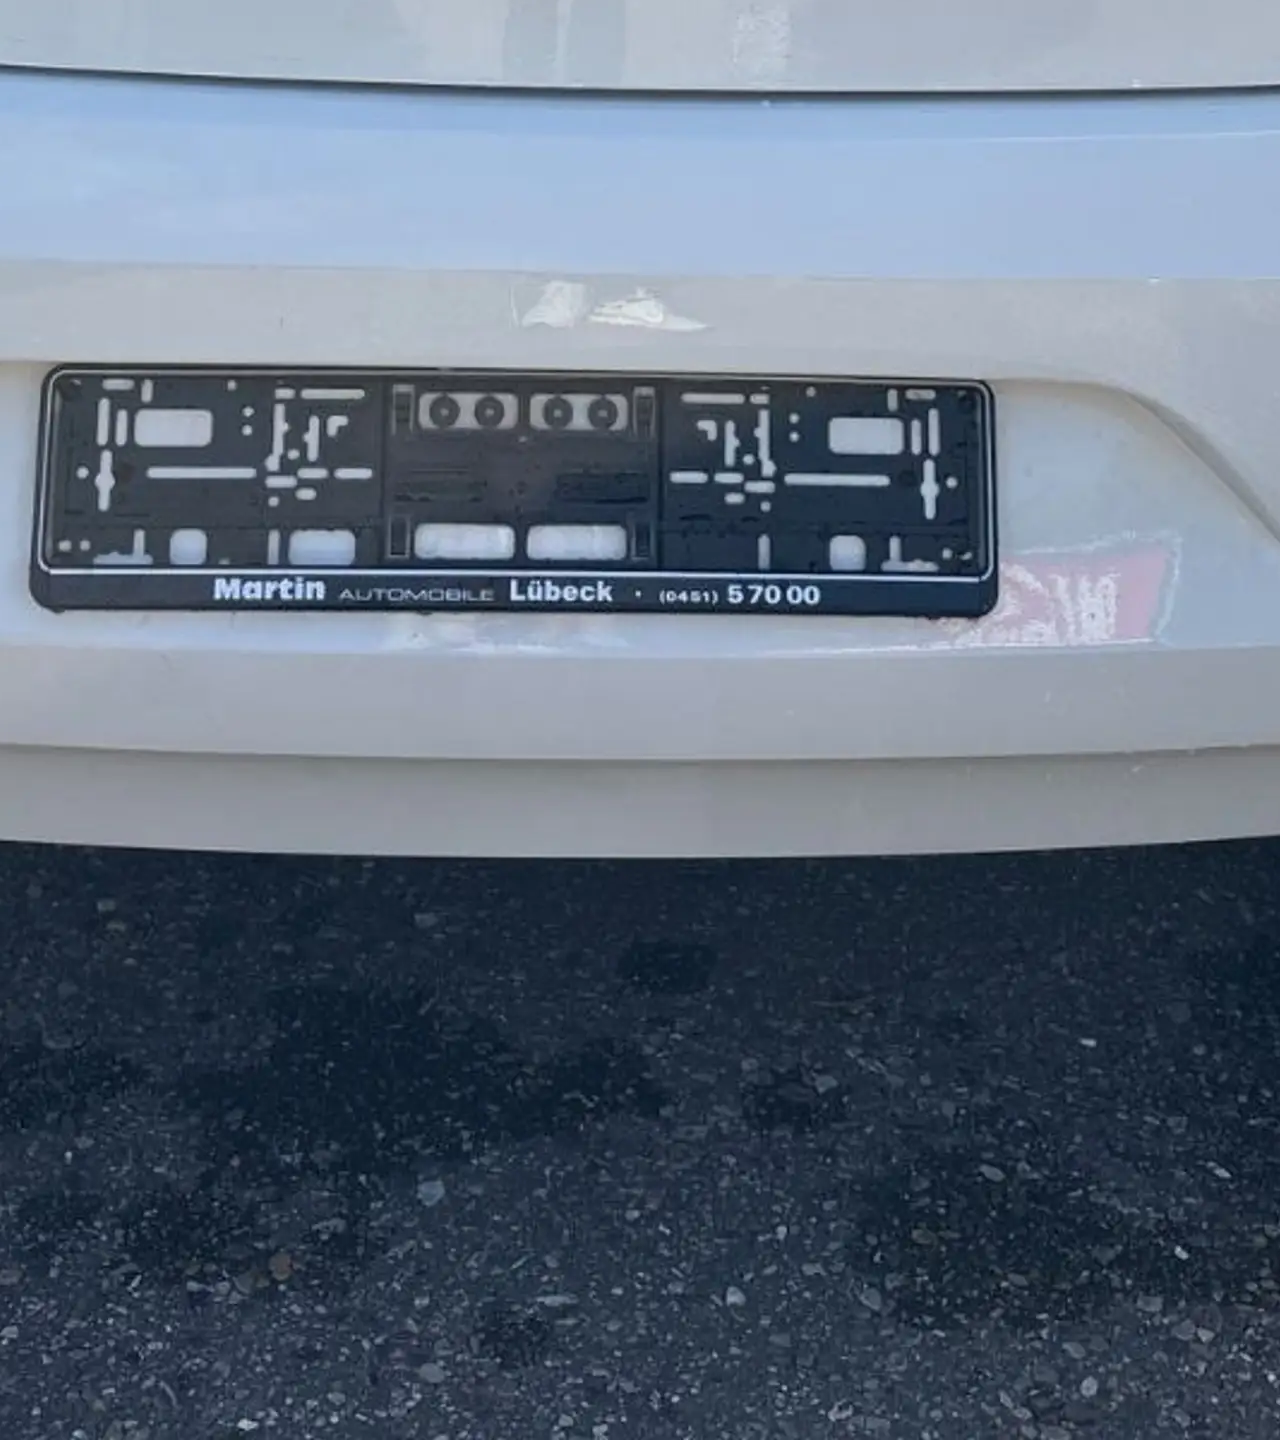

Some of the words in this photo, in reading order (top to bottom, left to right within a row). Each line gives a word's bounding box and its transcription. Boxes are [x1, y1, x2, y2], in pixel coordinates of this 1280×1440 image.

[213, 577, 326, 601] Martin
[338, 587, 495, 603] AUTOMOBILE
[509, 578, 614, 603] Lübeck
[659, 590, 719, 605] (0451)
